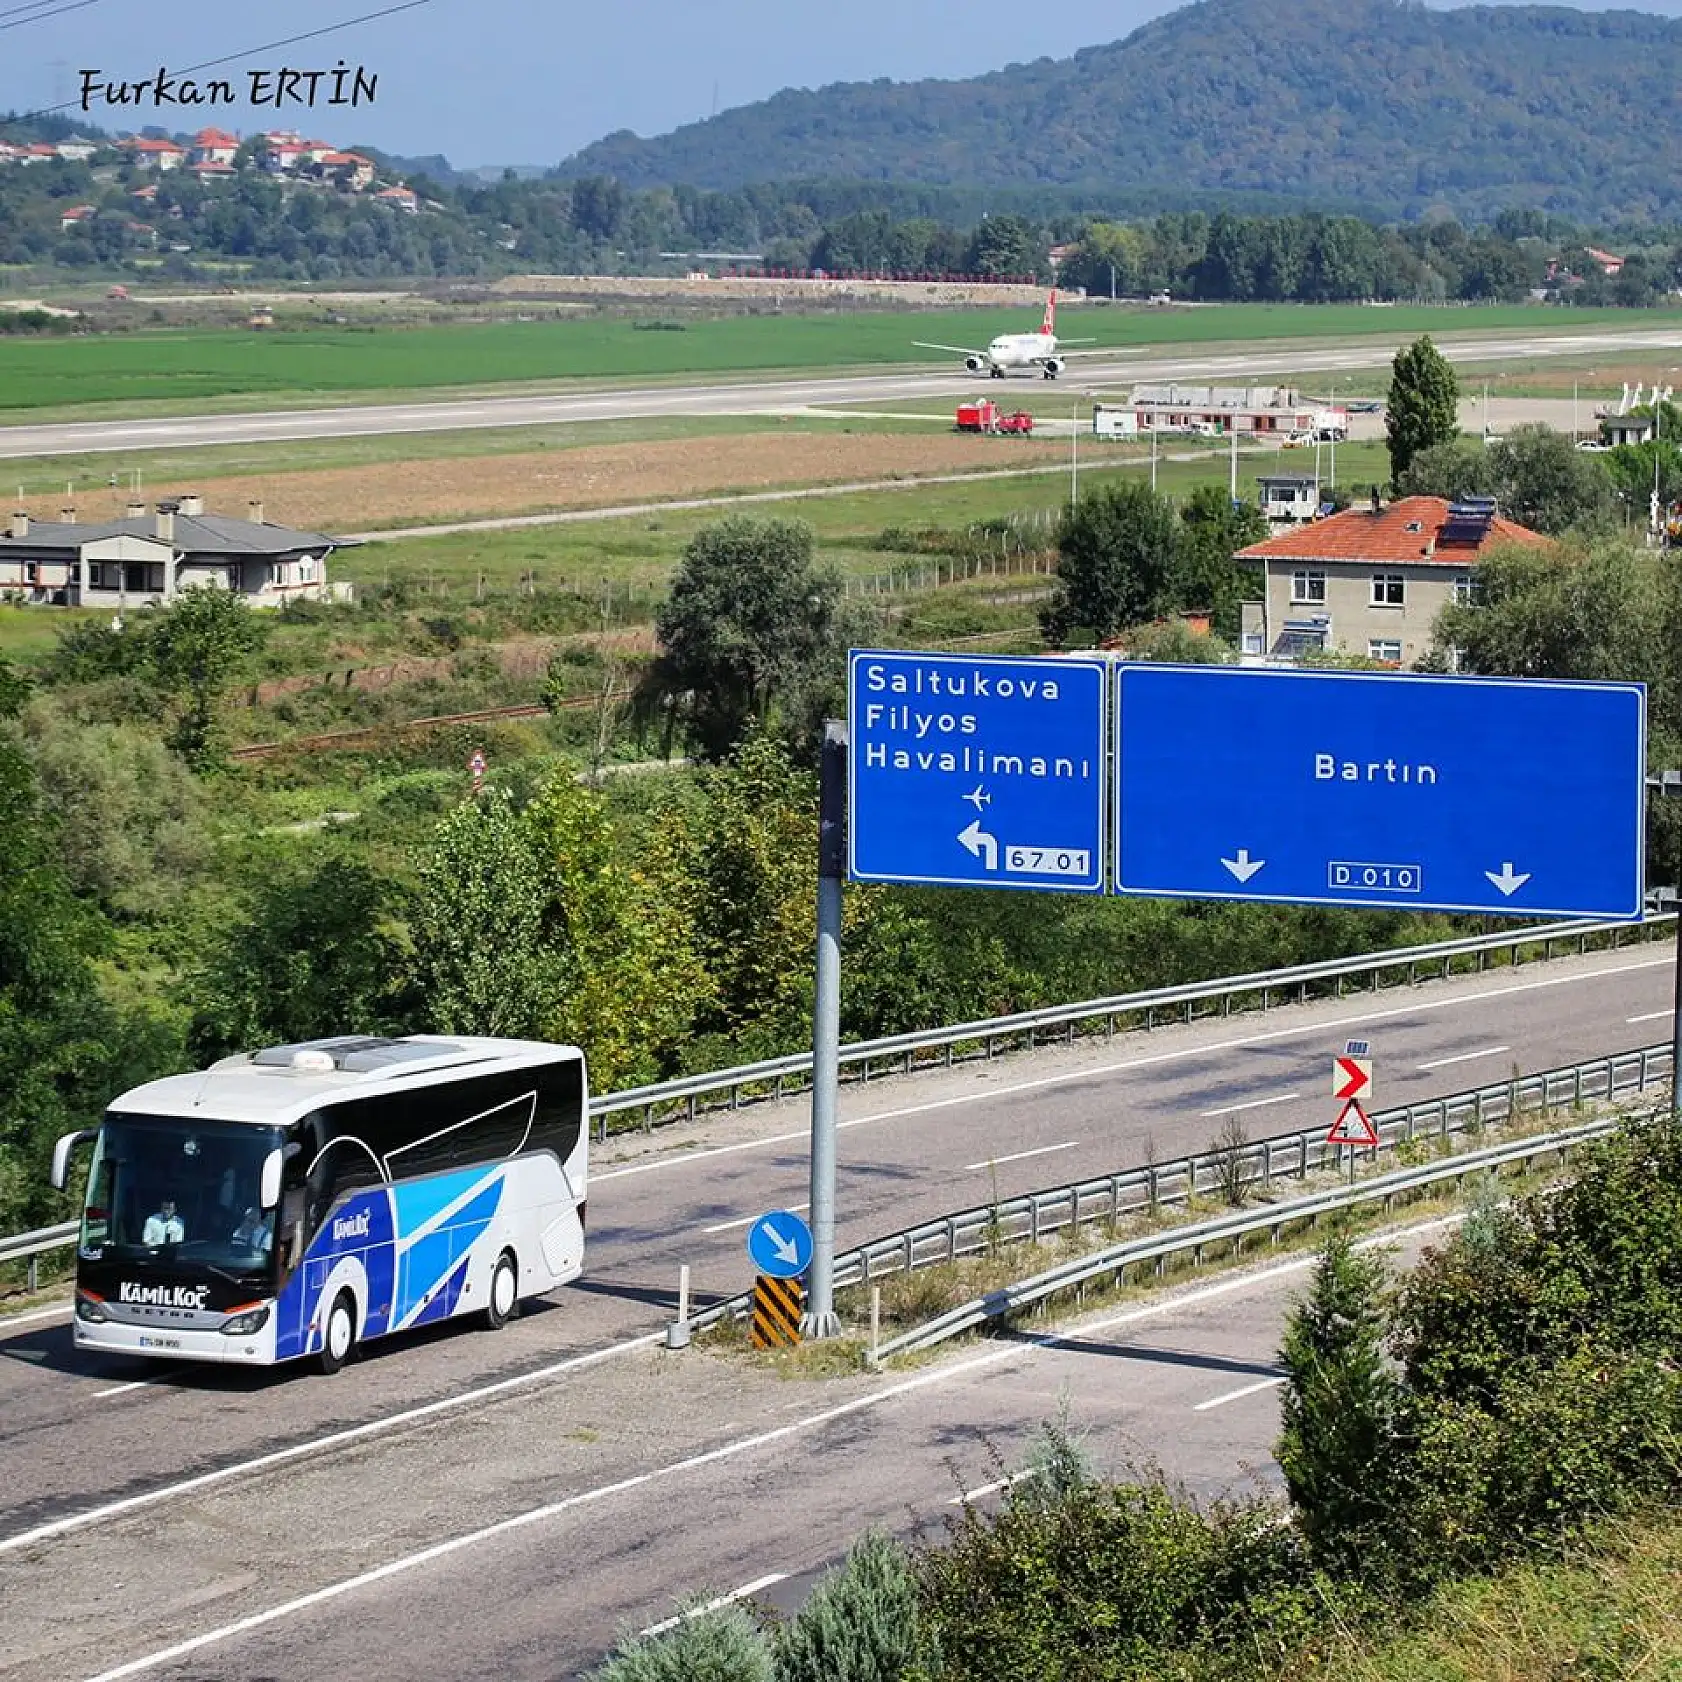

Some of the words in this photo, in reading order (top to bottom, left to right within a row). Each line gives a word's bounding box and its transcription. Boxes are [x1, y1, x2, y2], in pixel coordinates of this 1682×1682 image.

[867, 666, 1059, 700] Saltukova
[866, 704, 977, 738] Filyos
[866, 743, 1089, 778] Havalimanı
[1315, 753, 1436, 784] Bartın
[1336, 866, 1413, 887] D.010
